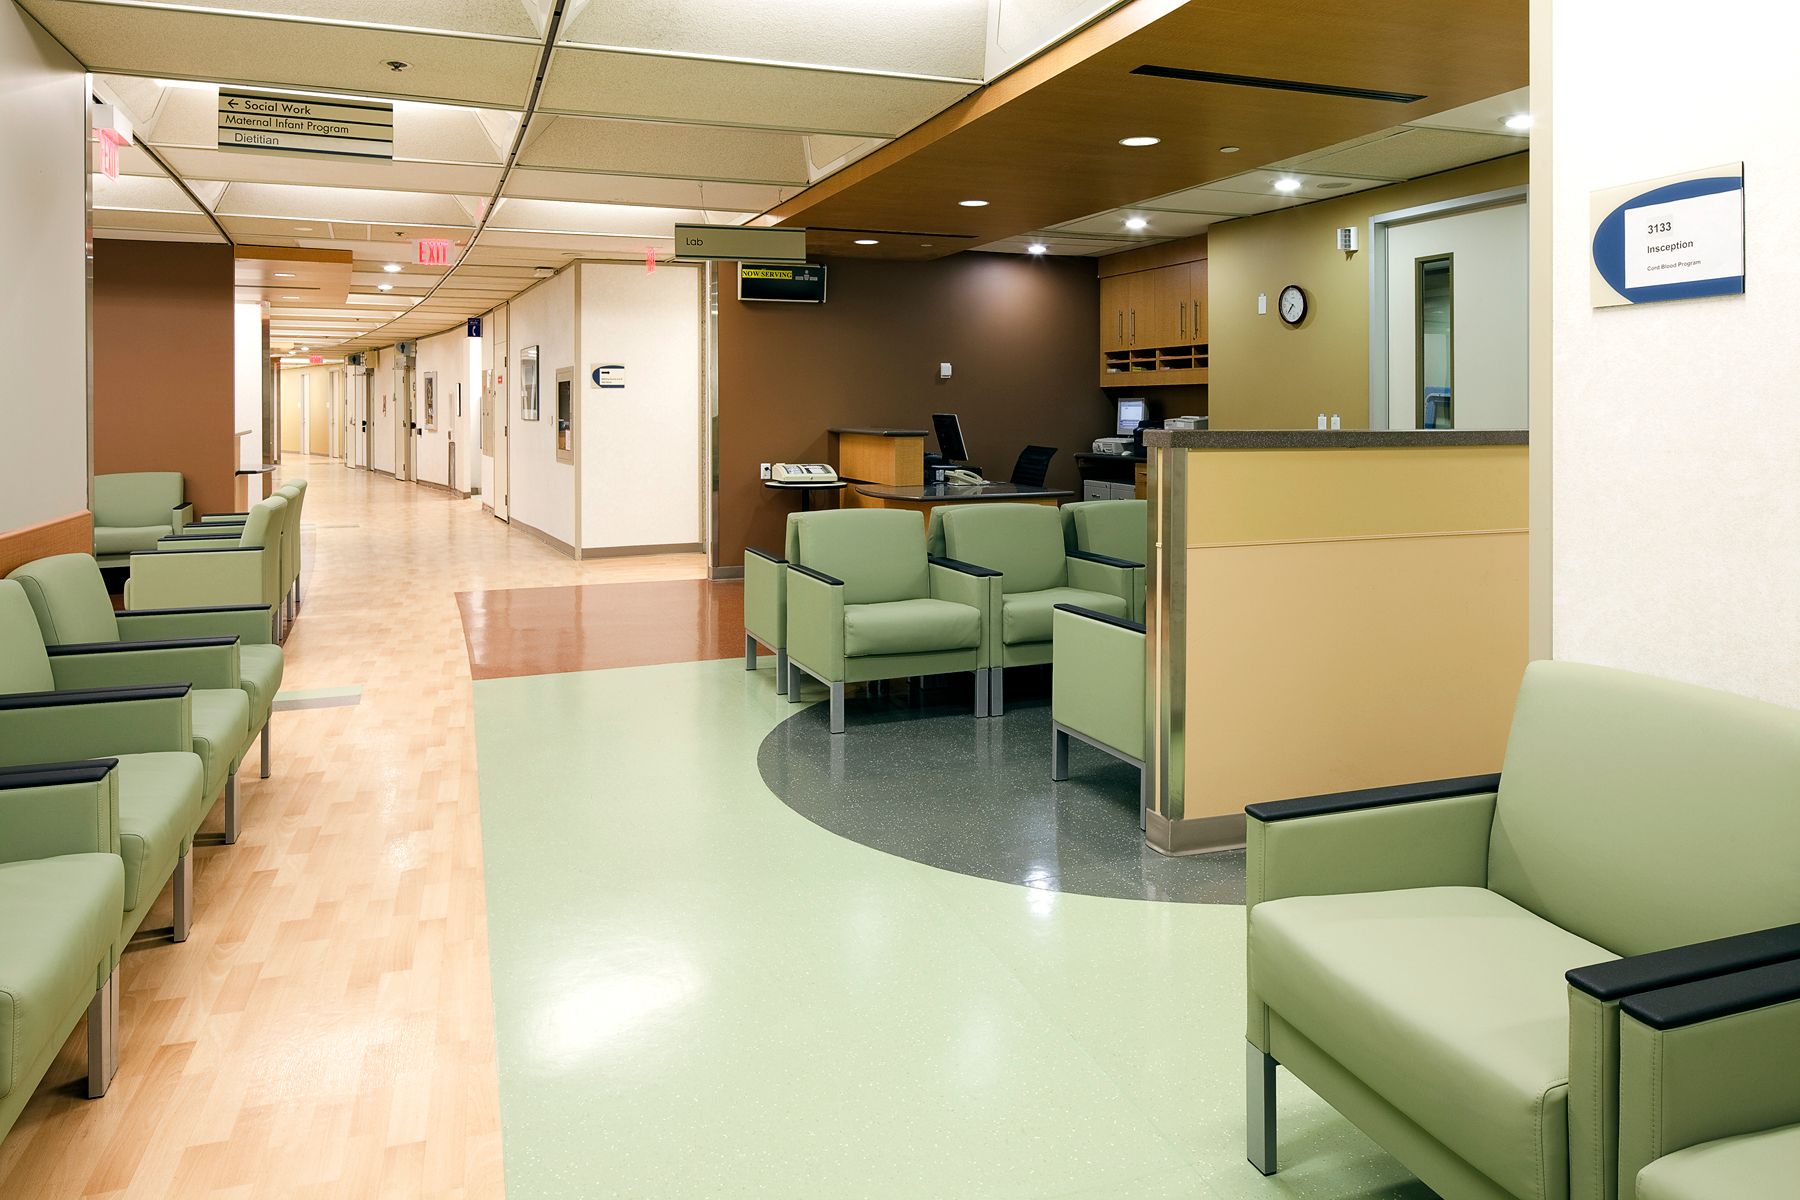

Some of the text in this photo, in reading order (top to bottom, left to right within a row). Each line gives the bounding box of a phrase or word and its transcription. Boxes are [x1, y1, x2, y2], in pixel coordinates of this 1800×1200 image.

[244, 100, 311, 115] Social Work
[225, 114, 349, 134] Maternal Infant Program
[234, 132, 279, 145] Dietitian
[1647, 221, 1672, 234] 3133
[685, 237, 704, 246] Lab
[1647, 240, 1694, 253] Insception
[418, 241, 449, 265] EXIT
[1661, 262, 1677, 270] Blood
[742, 270, 759, 278] NOW
[761, 271, 793, 279] SERVING
